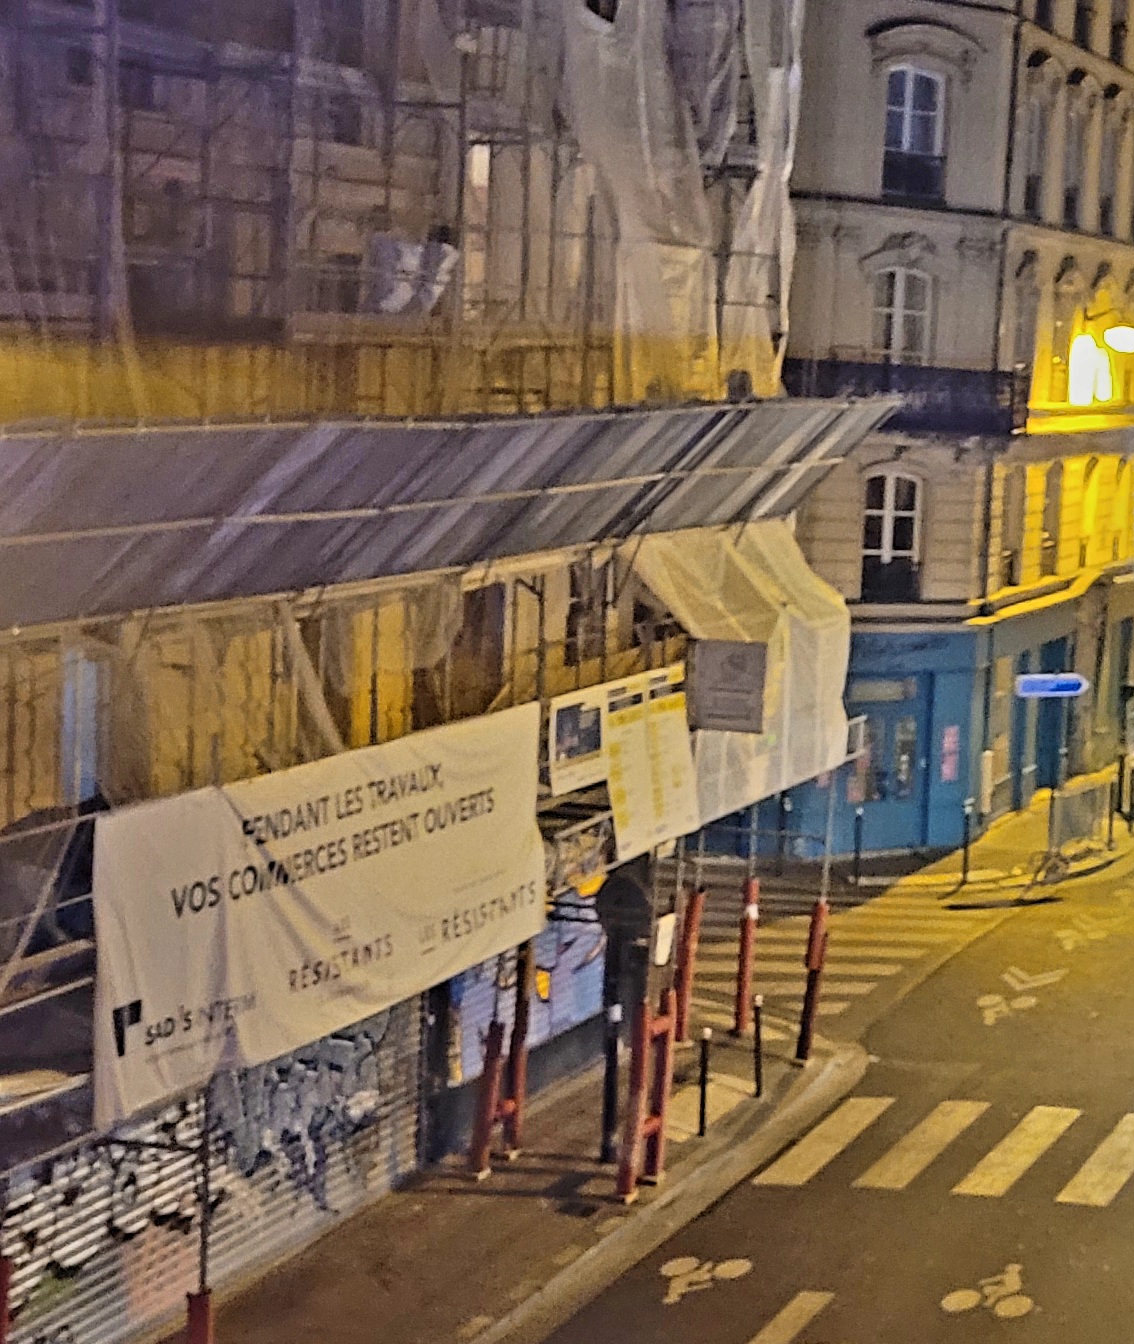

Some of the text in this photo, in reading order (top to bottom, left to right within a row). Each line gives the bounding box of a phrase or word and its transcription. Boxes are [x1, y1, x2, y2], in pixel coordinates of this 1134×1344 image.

[170, 787, 495, 918] VOS COMMERCES RESTENT OUVERTS
[242, 797, 332, 844] PENDANT
[335, 787, 363, 820] LES
